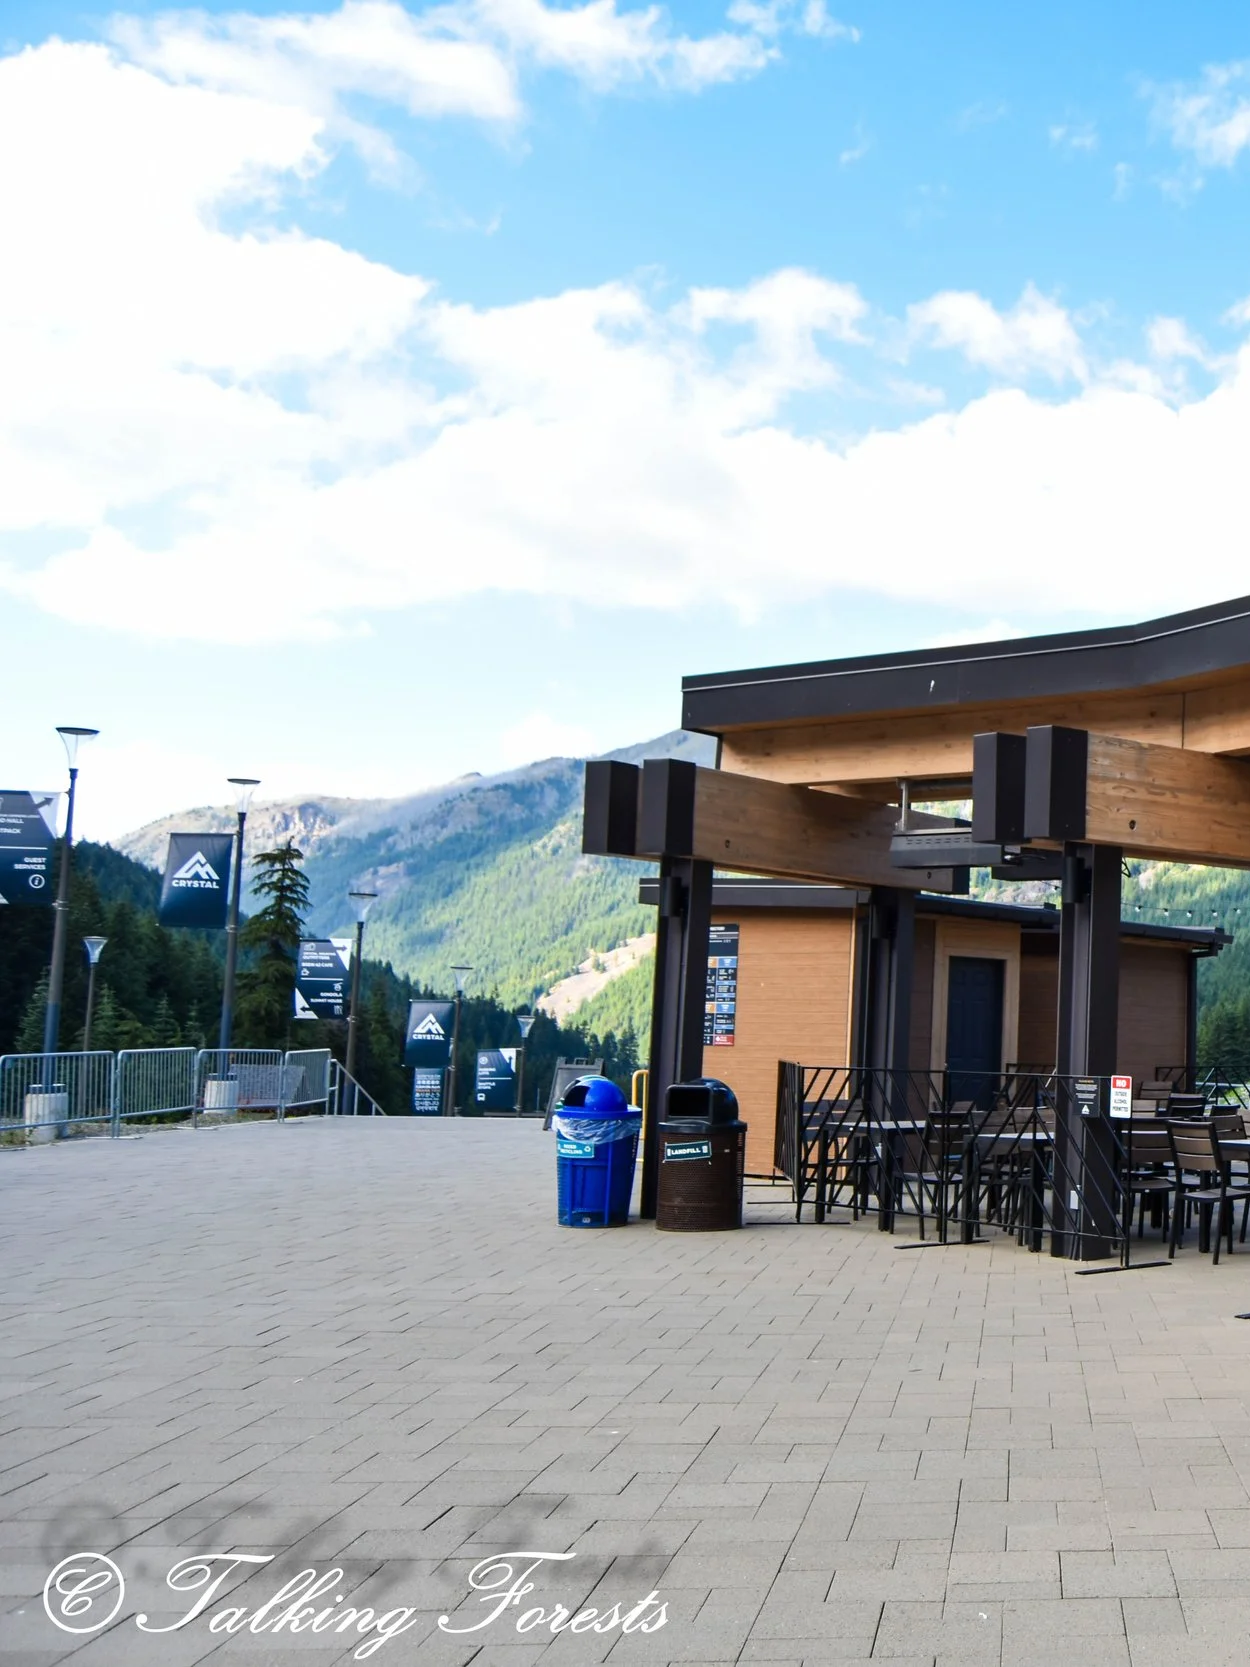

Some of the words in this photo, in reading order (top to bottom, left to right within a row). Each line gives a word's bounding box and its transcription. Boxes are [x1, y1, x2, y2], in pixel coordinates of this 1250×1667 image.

[172, 880, 219, 889] CRYSTAL
[1116, 1079, 1127, 1087] NO
[671, 1147, 701, 1155] LANDFILL
